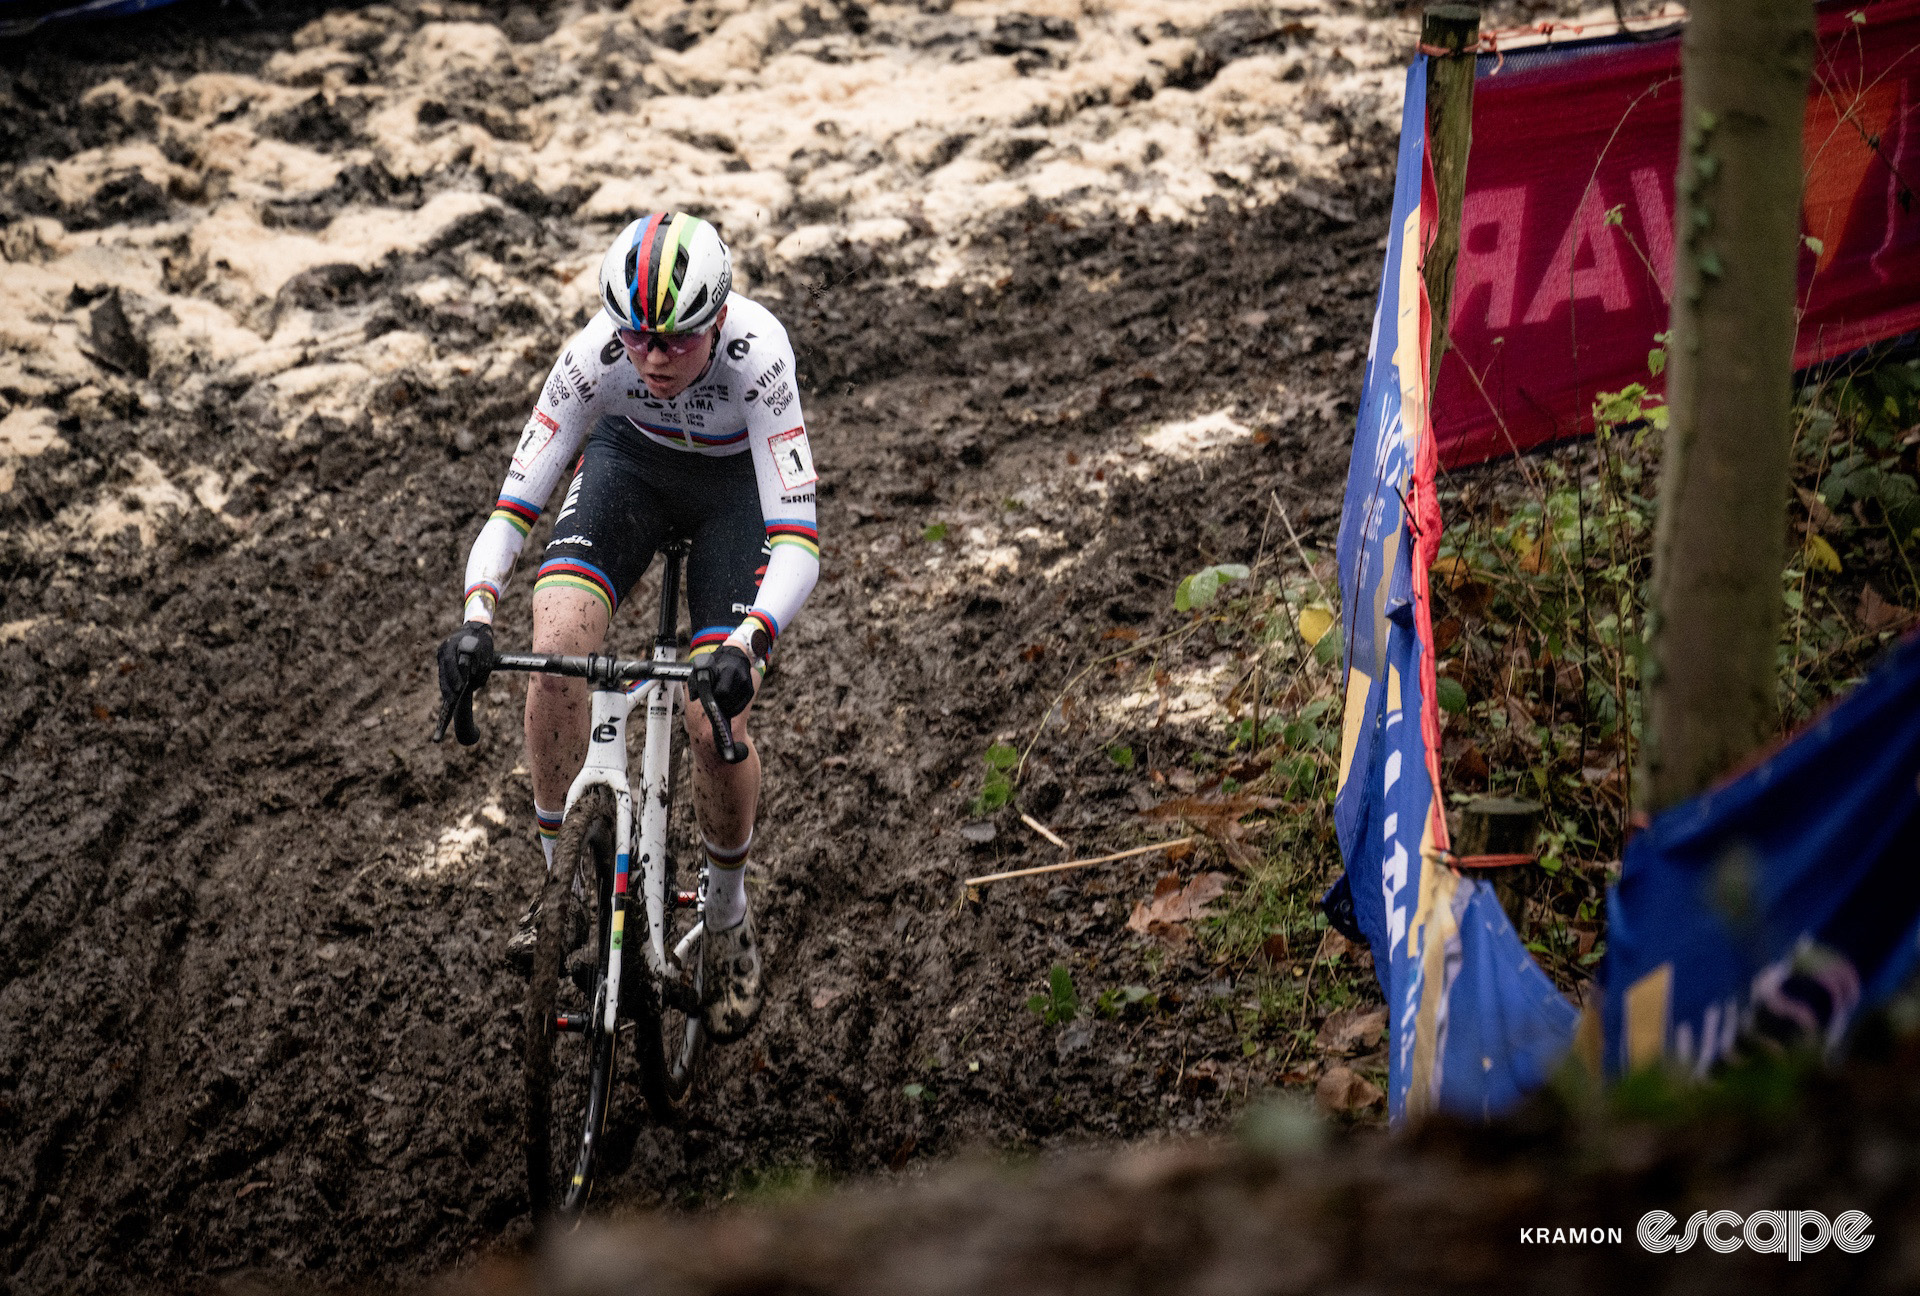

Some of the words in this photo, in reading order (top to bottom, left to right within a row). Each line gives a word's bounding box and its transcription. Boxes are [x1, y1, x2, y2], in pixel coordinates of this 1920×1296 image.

[568, 364, 595, 403] VISMA
[756, 358, 786, 388] VISMA
[763, 382, 789, 408] lease
[521, 430, 536, 452] 1
[789, 448, 804, 472] 1
